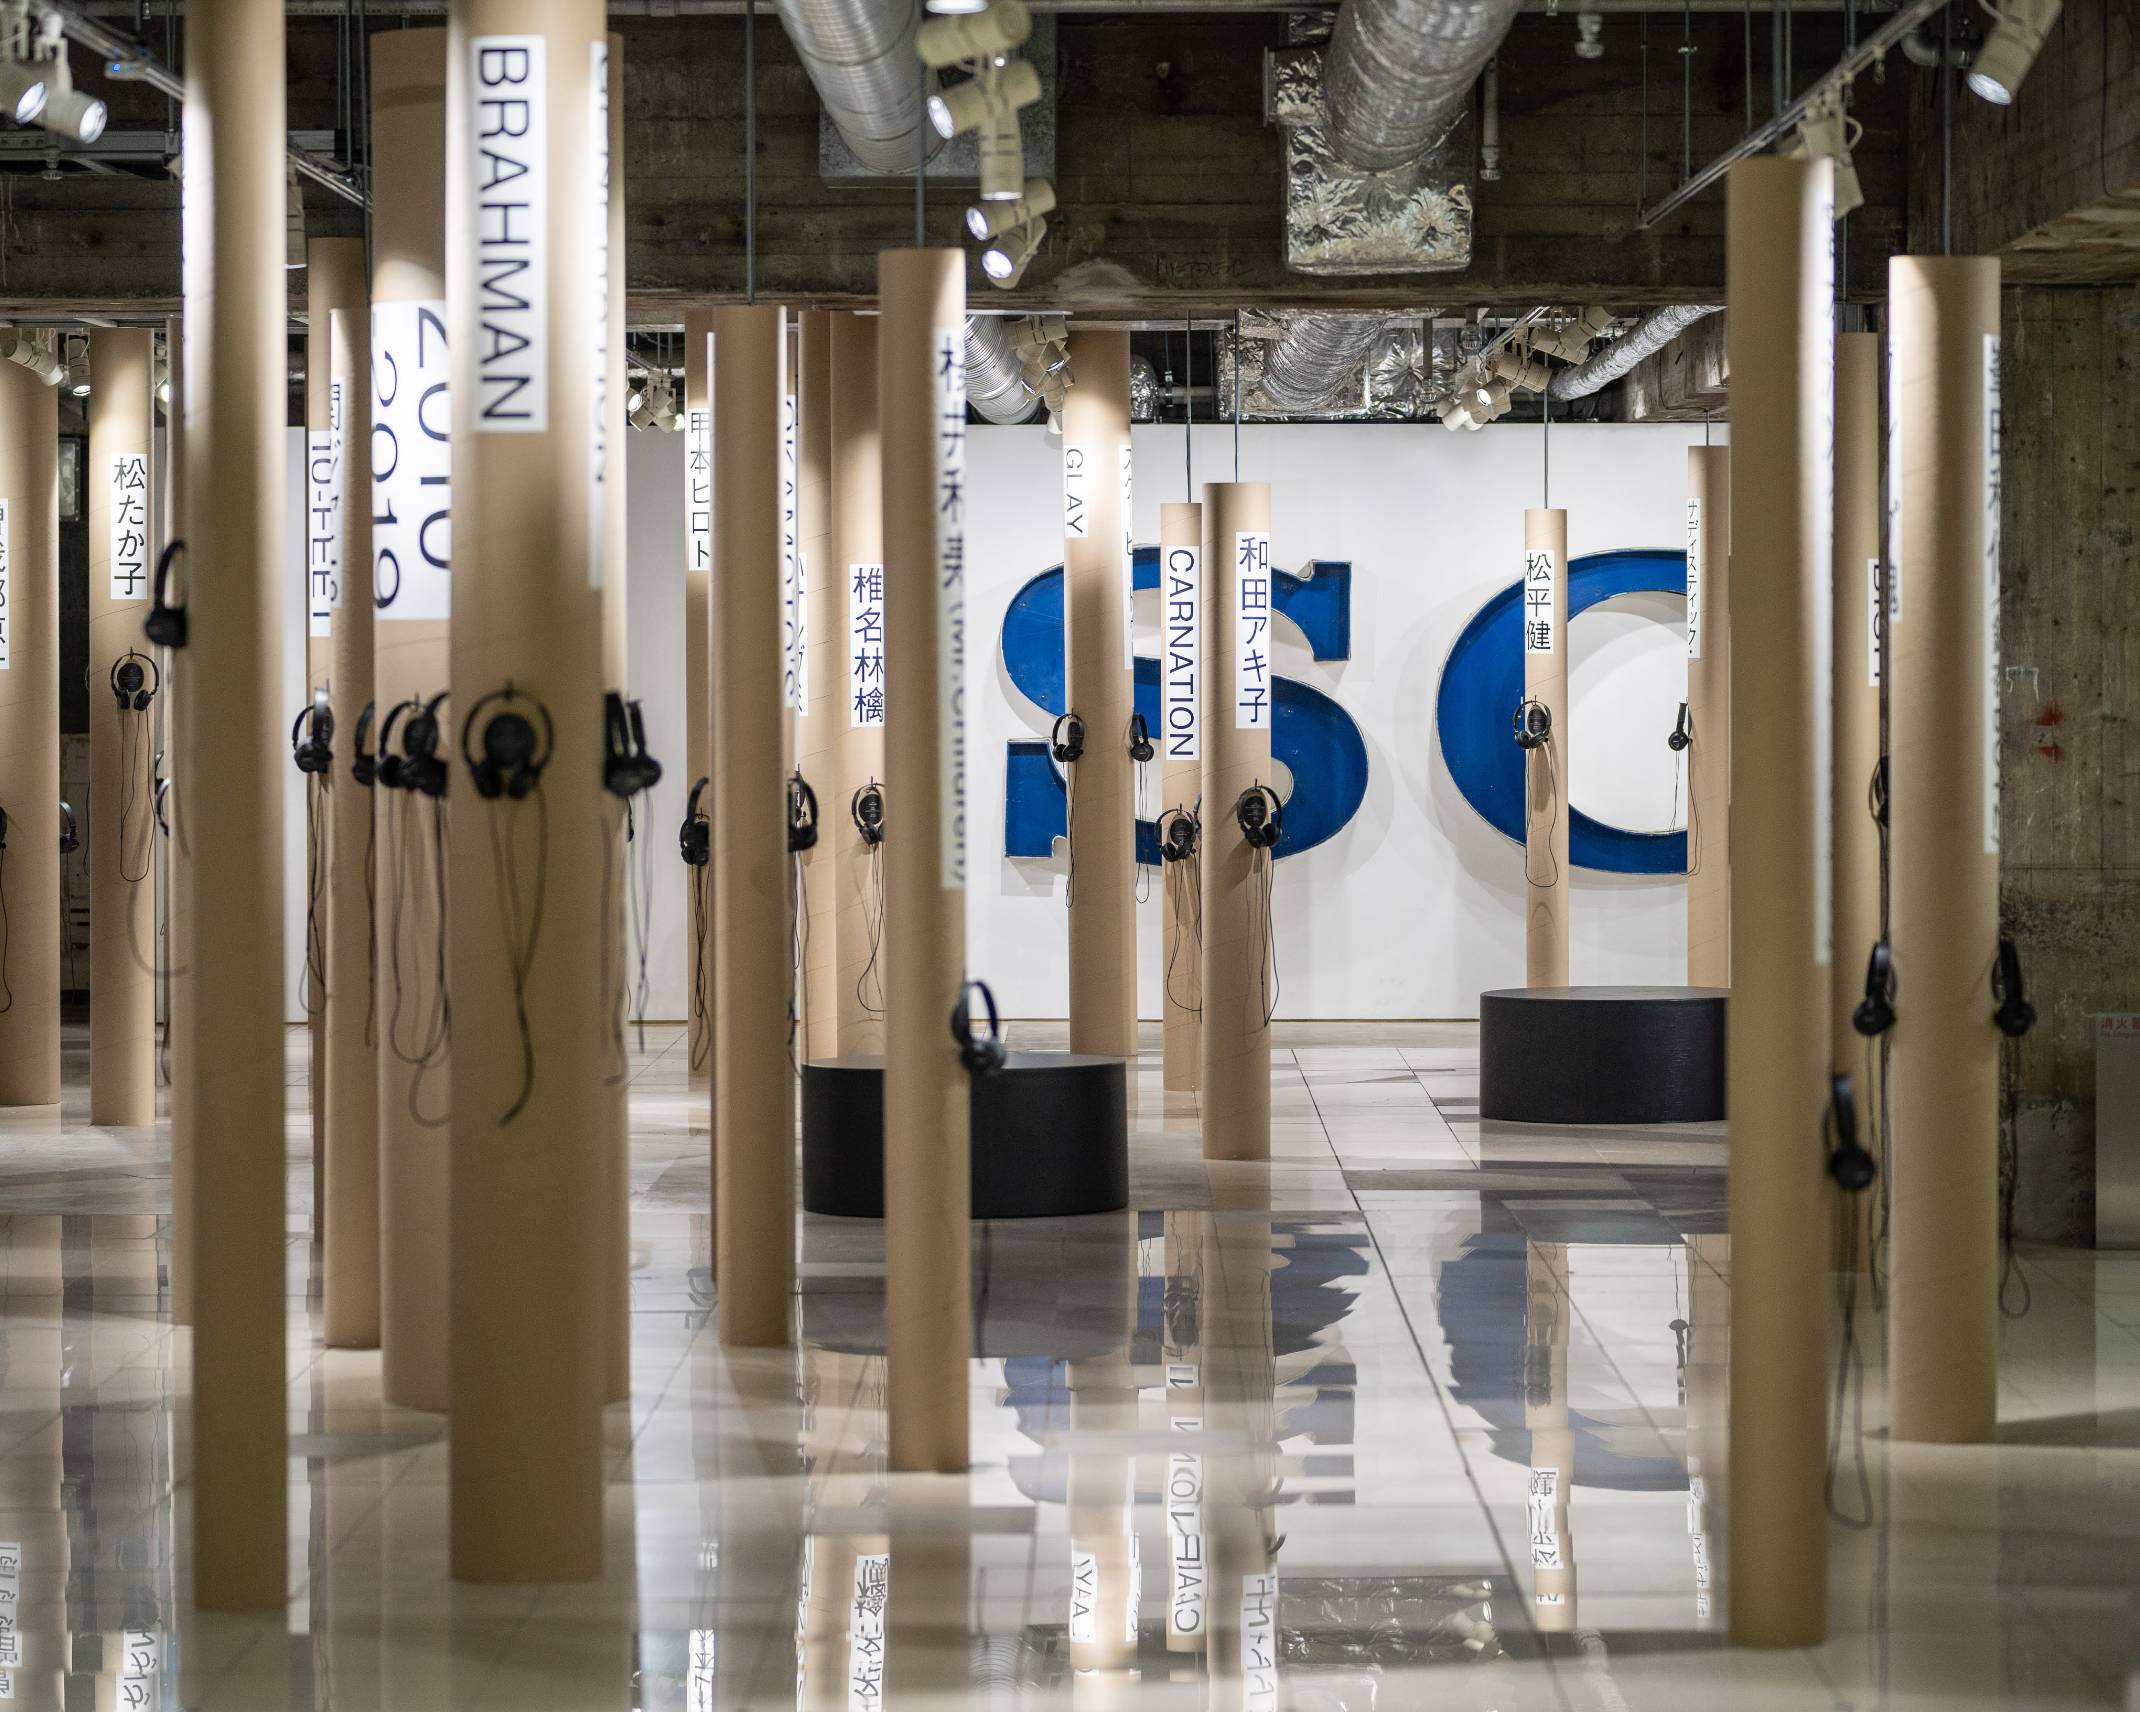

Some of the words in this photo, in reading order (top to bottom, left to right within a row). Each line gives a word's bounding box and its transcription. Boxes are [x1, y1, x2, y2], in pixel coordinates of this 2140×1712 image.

[479, 46, 532, 422] BRAHMAN
[113, 457, 146, 595] 松たか子
[690, 412, 710, 567] 甲本ヒロト
[1065, 449, 1083, 533] GLAY
[853, 566, 883, 724] 椎名林檎
[1168, 548, 1194, 757] CARNATION
[1239, 536, 1268, 724] 和田アキ子
[1526, 553, 1552, 651] 松平健
